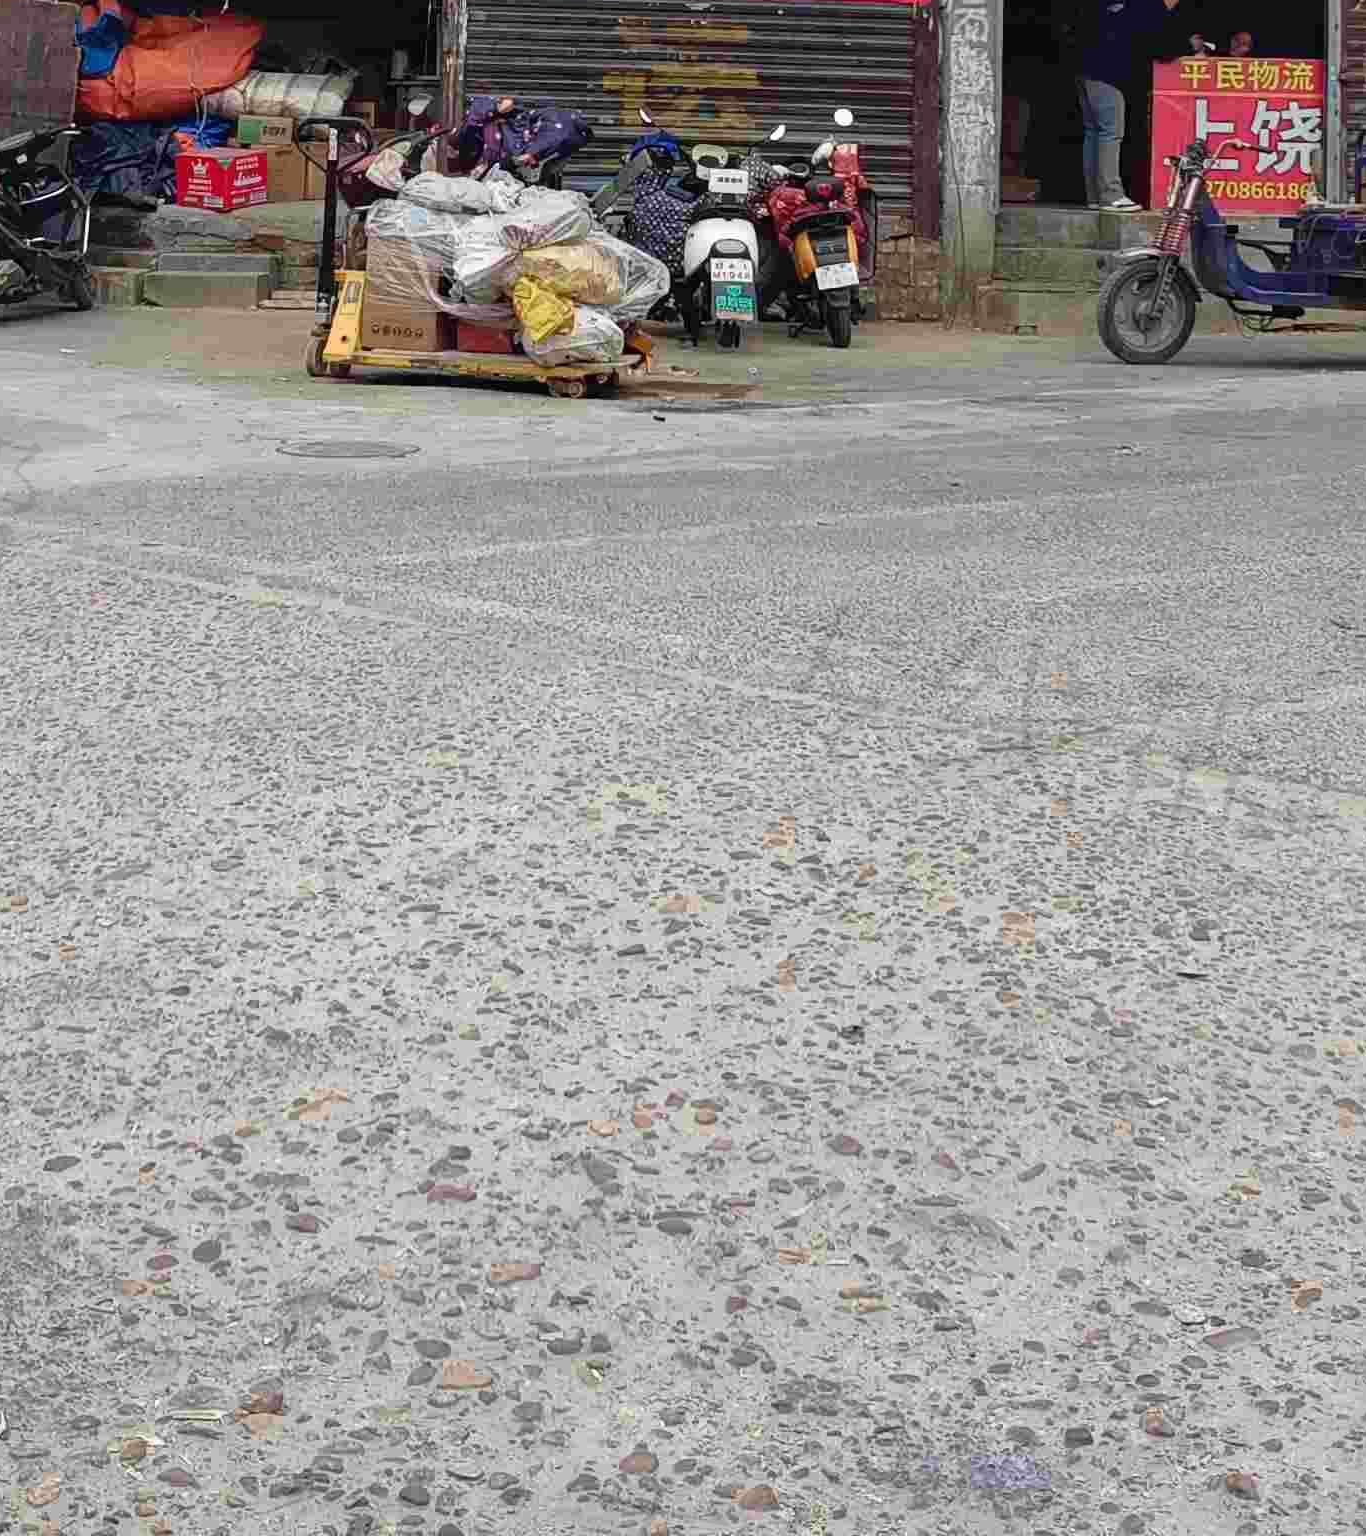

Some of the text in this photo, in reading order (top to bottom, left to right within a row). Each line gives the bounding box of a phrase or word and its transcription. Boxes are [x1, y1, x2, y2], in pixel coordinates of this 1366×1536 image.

[1180, 61, 1315, 91] 平民物流
[1188, 99, 1323, 175] 上饶
